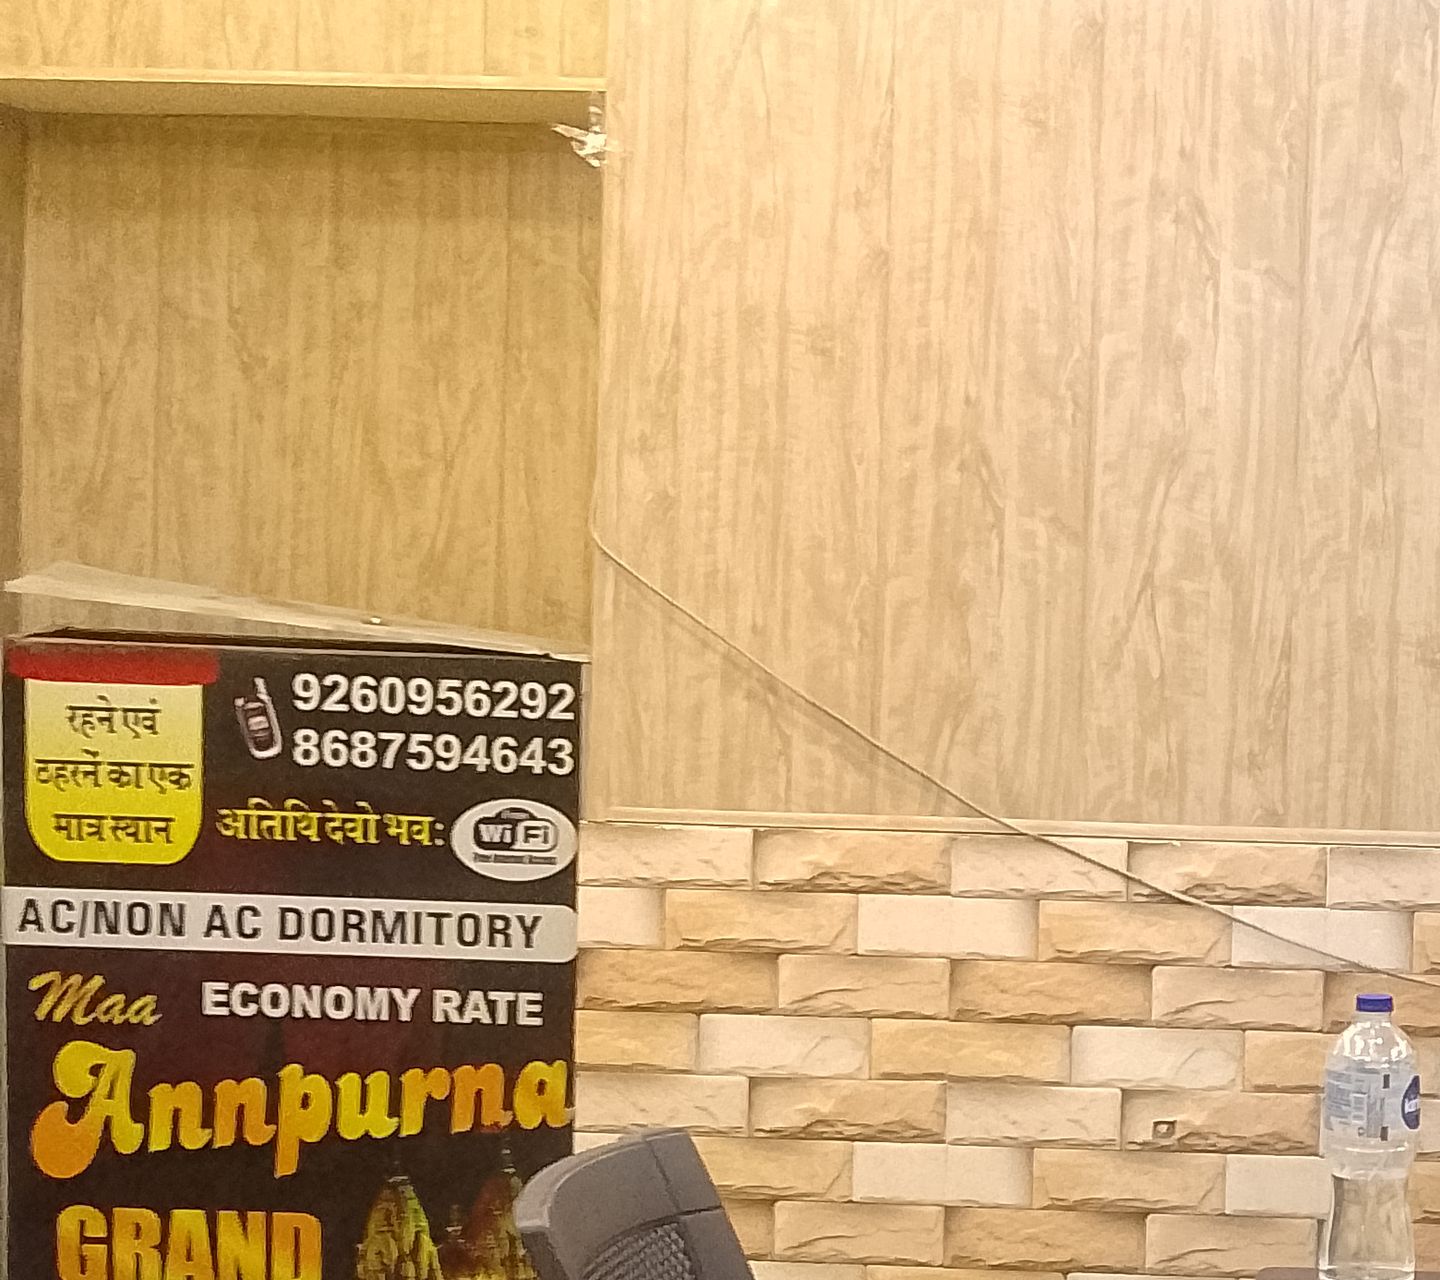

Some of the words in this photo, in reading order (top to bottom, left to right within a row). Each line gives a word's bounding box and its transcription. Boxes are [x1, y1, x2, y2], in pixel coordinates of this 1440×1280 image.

[65, 694, 118, 739] रहने
[119, 698, 162, 739] एवं
[291, 673, 576, 720] 9260956292
[291, 729, 575, 775] 8687594643
[106, 761, 146, 790] का
[148, 762, 194, 794] एक
[322, 799, 381, 845] देवो
[17, 899, 187, 938] AC/NON
[203, 904, 262, 940] AC
[278, 906, 543, 949] DORMITORY
[28, 970, 163, 1026] Maa
[201, 981, 420, 1022] ECONOMY
[432, 989, 544, 1026] RATE
[30, 1040, 574, 1179] Annpurna
